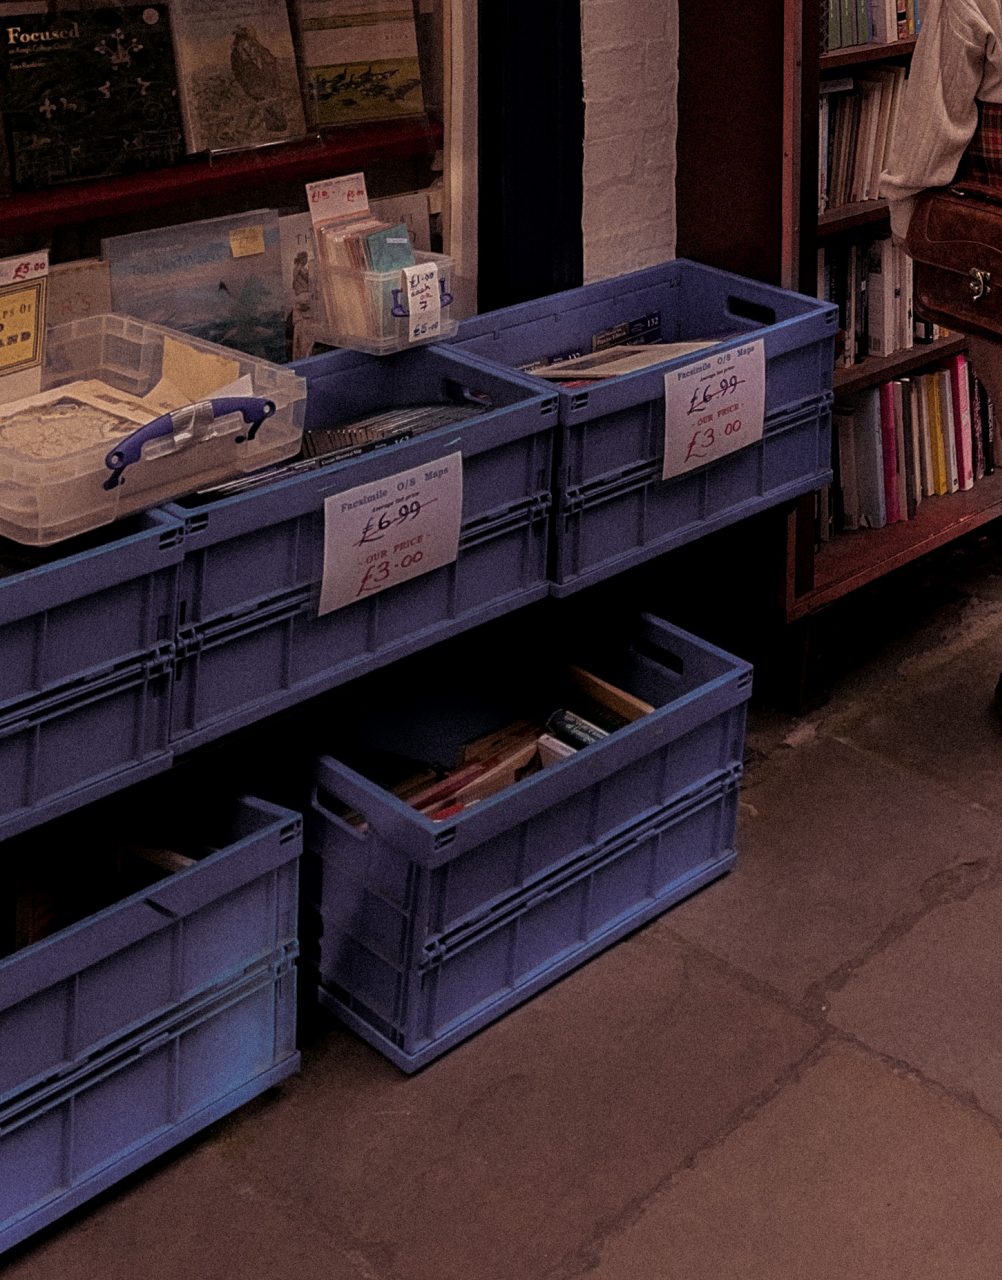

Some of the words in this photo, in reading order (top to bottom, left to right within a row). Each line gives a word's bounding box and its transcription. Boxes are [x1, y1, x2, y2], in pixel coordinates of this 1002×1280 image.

[5, 21, 80, 45] Focused
[12, 262, 46, 280] £5.00
[677, 362, 712, 381] Facsimile
[736, 346, 755, 357] Maps
[697, 413, 714, 426] OUR
[717, 402, 740, 418] PRICE
[340, 488, 389, 514] Facsimile
[396, 477, 417, 492] O/S
[424, 467, 450, 482] Maps
[366, 549, 388, 565] OUR
[393, 534, 425, 553] PRICE
